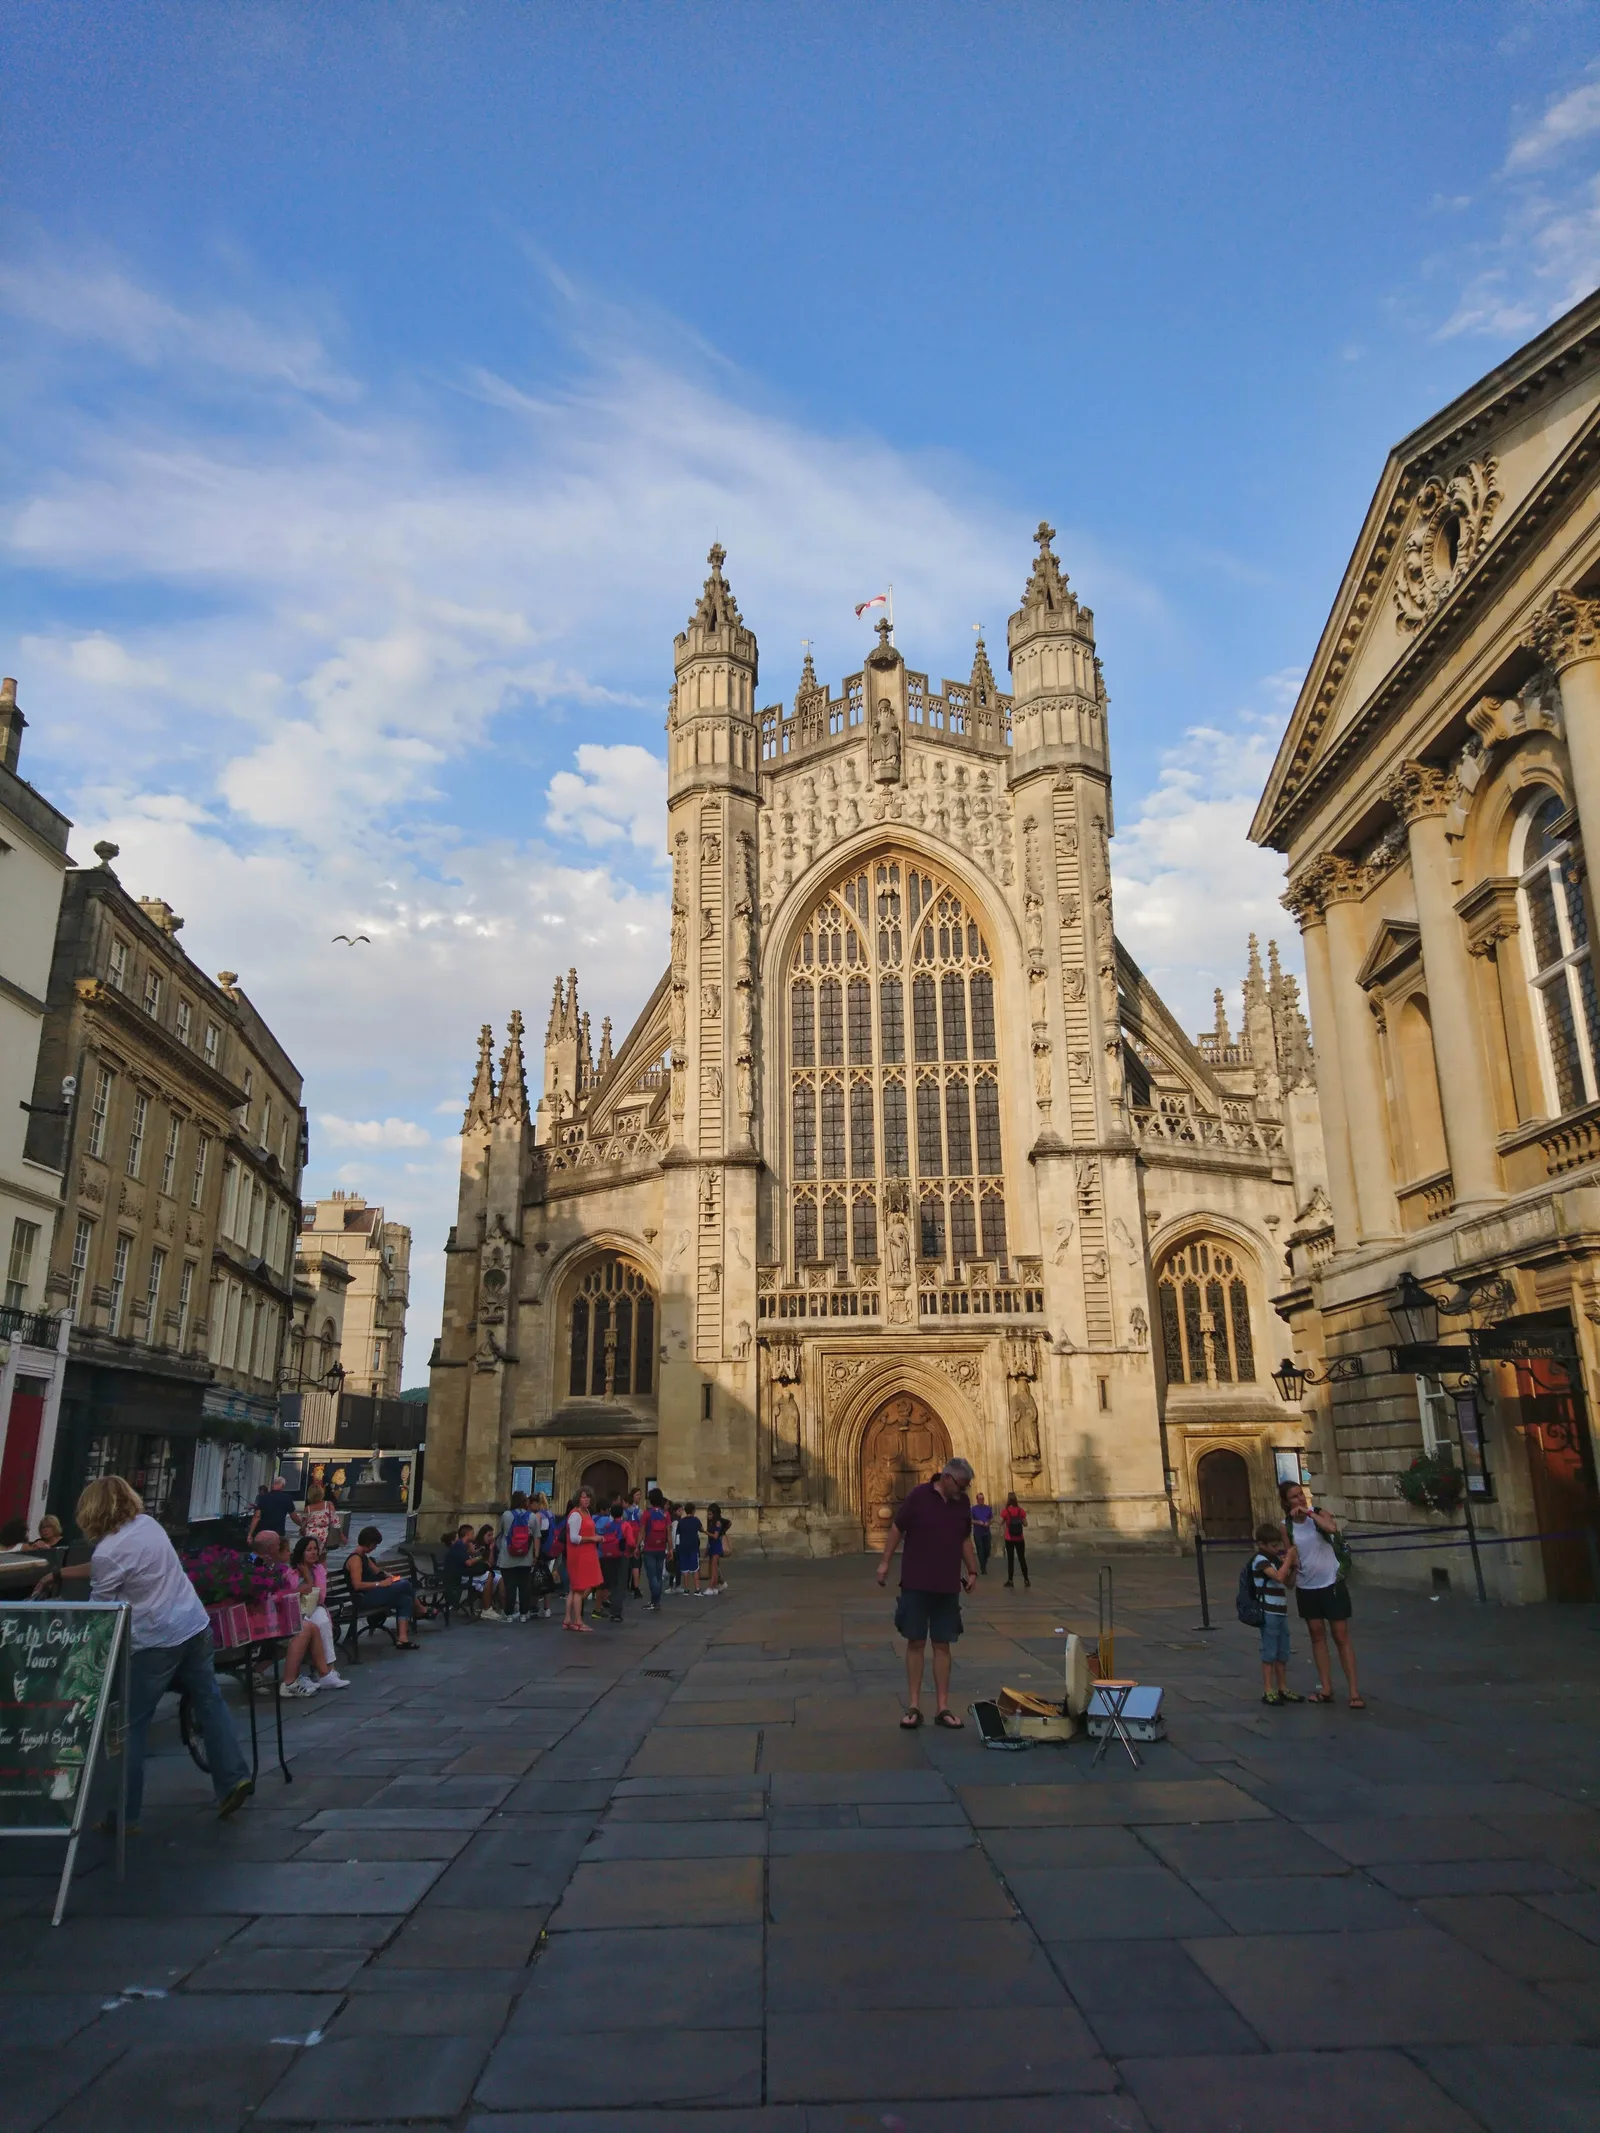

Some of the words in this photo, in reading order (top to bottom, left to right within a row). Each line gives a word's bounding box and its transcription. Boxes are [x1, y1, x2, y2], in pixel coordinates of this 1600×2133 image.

[1489, 1347, 1523, 1356] ROMAN
[1527, 1347, 1554, 1356] BATHS
[1512, 1339, 1529, 1348] THE
[0, 1618, 40, 1648] Bath
[46, 1618, 90, 1650] Ghost
[20, 1643, 58, 1668] Tours
[18, 1727, 49, 1753] Tonight
[51, 1726, 79, 1748] 8pm!
